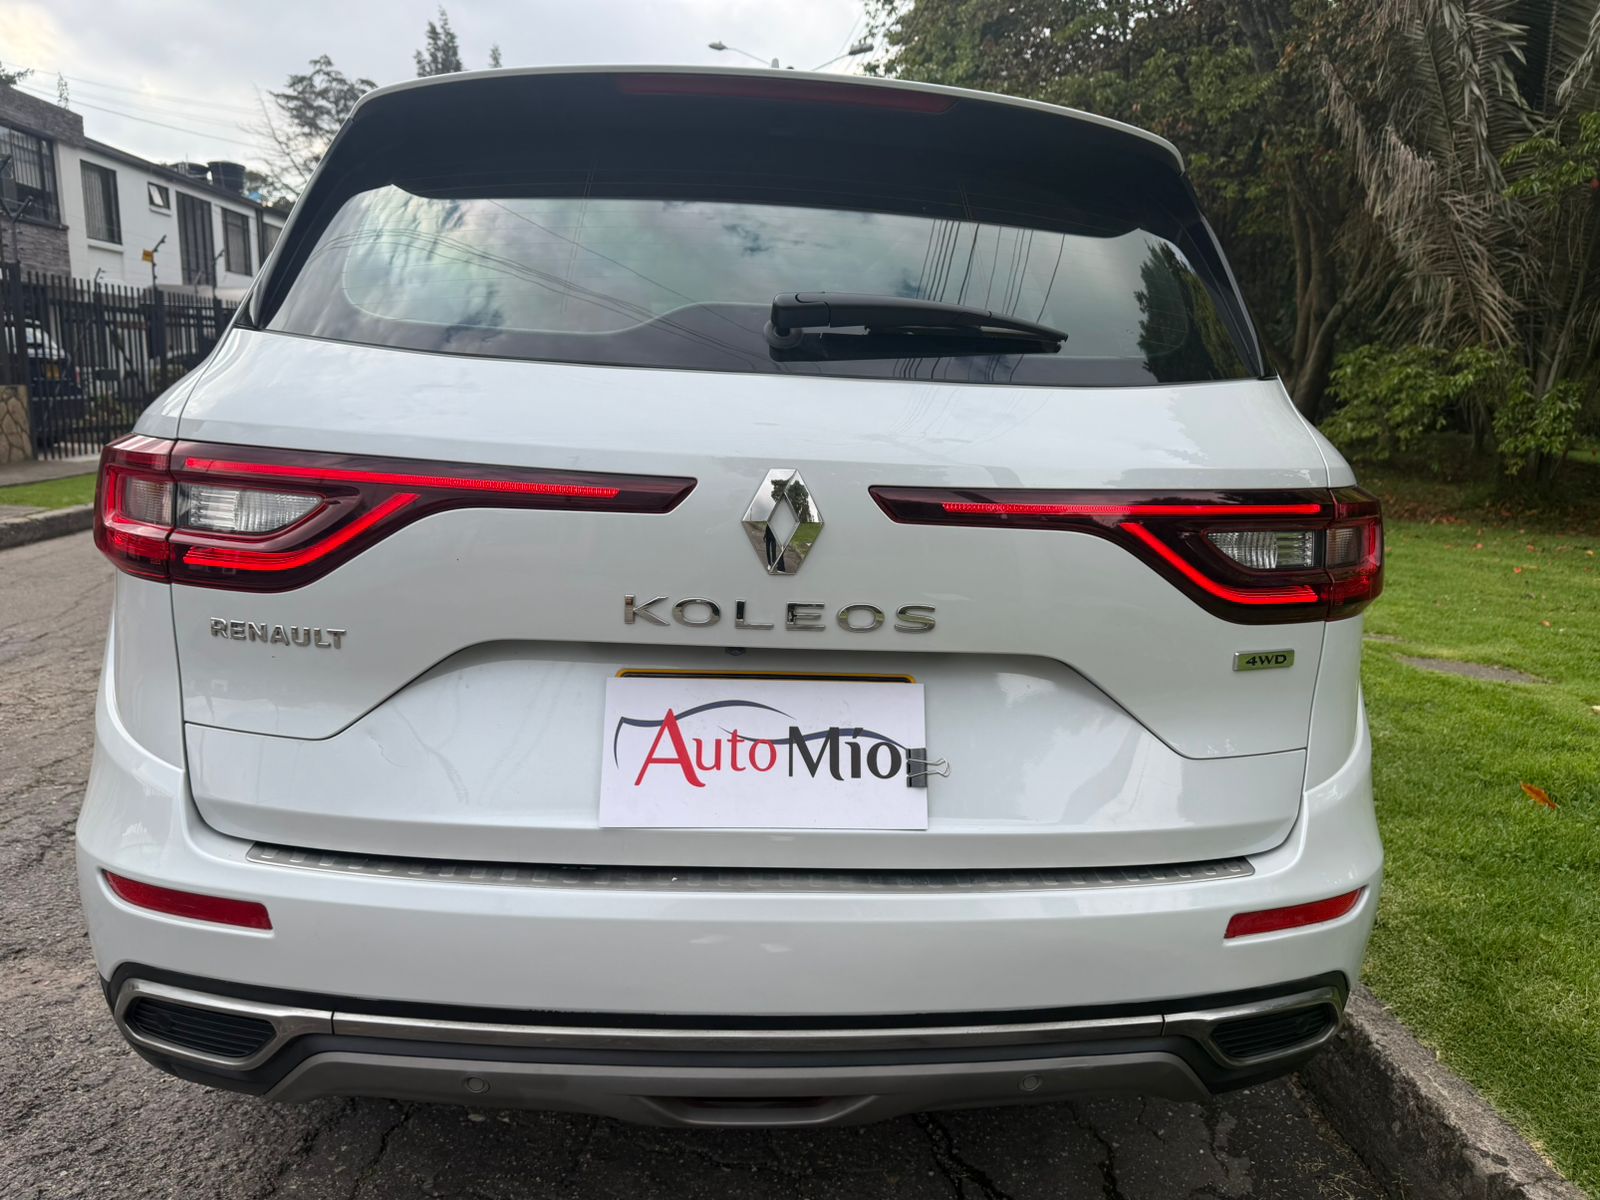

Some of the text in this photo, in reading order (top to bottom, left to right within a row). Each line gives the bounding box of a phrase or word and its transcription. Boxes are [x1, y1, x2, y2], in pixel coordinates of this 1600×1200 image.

[624, 594, 936, 633] KOLEOS
[210, 616, 347, 650] RENAULT
[1245, 654, 1288, 667] 4WD
[634, 708, 901, 787] Auto Mío
